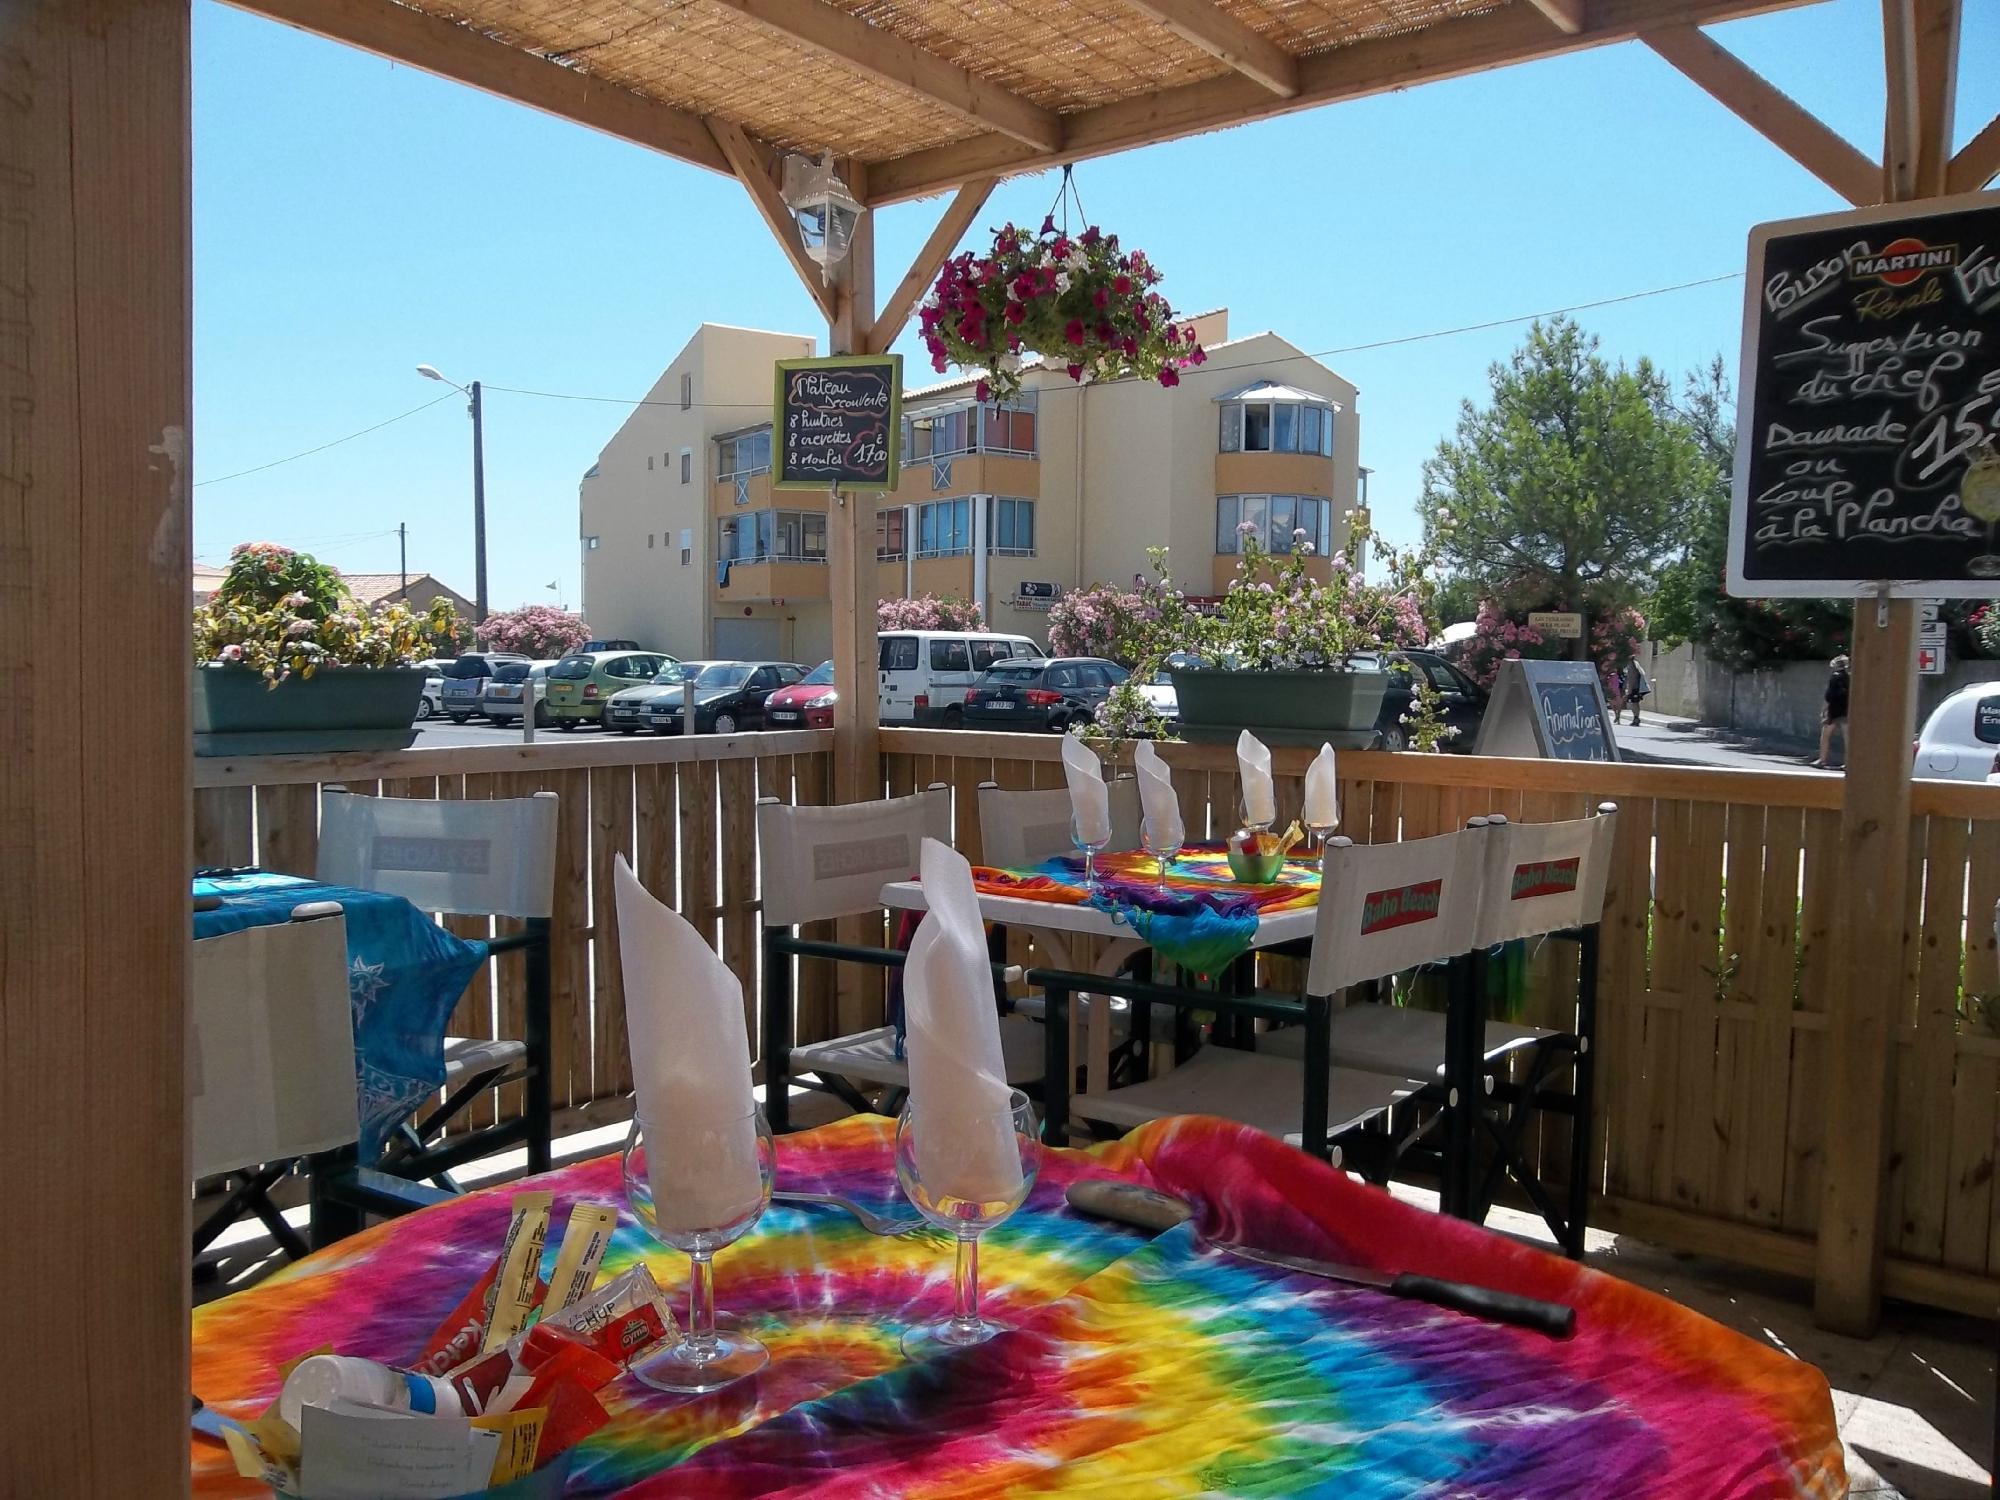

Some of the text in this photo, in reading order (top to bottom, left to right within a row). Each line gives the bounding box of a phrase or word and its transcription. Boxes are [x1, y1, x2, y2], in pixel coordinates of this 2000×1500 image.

[1856, 249, 1952, 275] MARTINI
[1797, 351, 1965, 413] du chef
[789, 414, 799, 428] 8
[1765, 409, 1908, 449] Daurade
[789, 434, 798, 447] 8
[789, 451, 798, 465] 8
[1785, 457, 1848, 476] ou
[1793, 507, 1829, 538] la
[573, 1302, 615, 1332] CHUP
